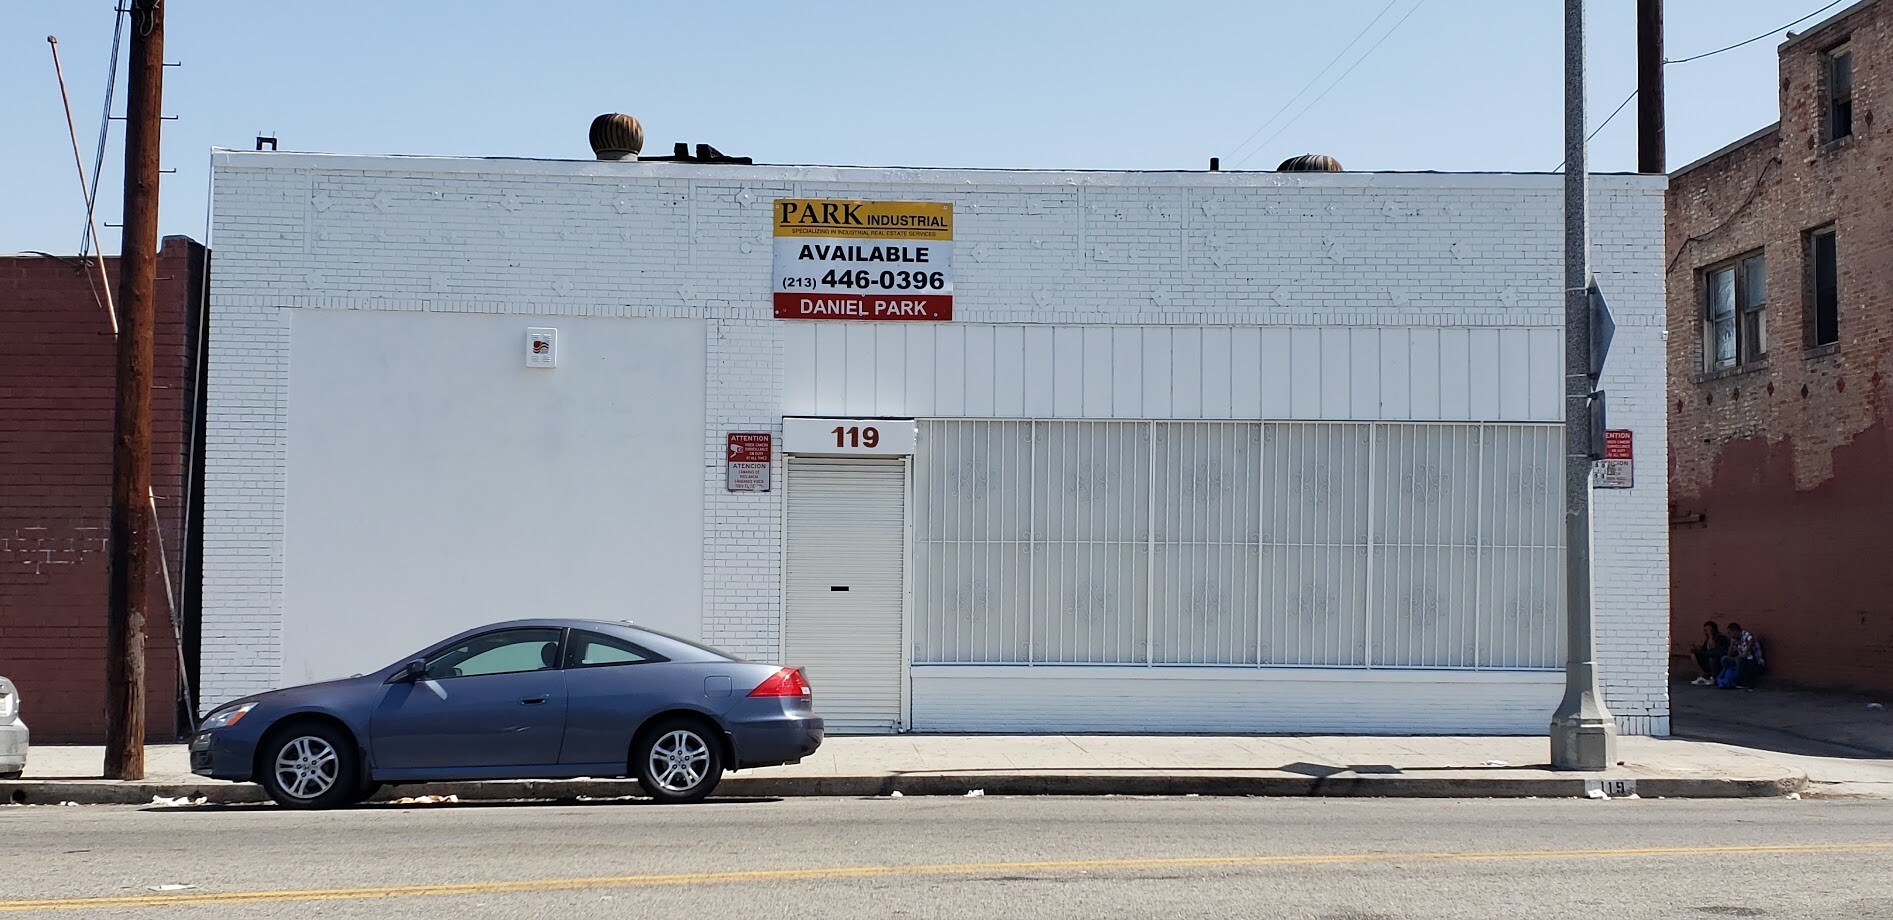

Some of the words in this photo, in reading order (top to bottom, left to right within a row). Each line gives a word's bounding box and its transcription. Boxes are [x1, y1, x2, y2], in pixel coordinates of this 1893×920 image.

[781, 202, 863, 225] PARK
[867, 214, 948, 227] INDUSTRIAL
[798, 244, 929, 262] AVAILABLE
[782, 277, 817, 290] (213)
[821, 269, 944, 289] 446-0396
[800, 298, 869, 316] DANIEL
[874, 300, 927, 316] PARK
[831, 426, 879, 448] 119
[1600, 780, 1625, 794] 119
